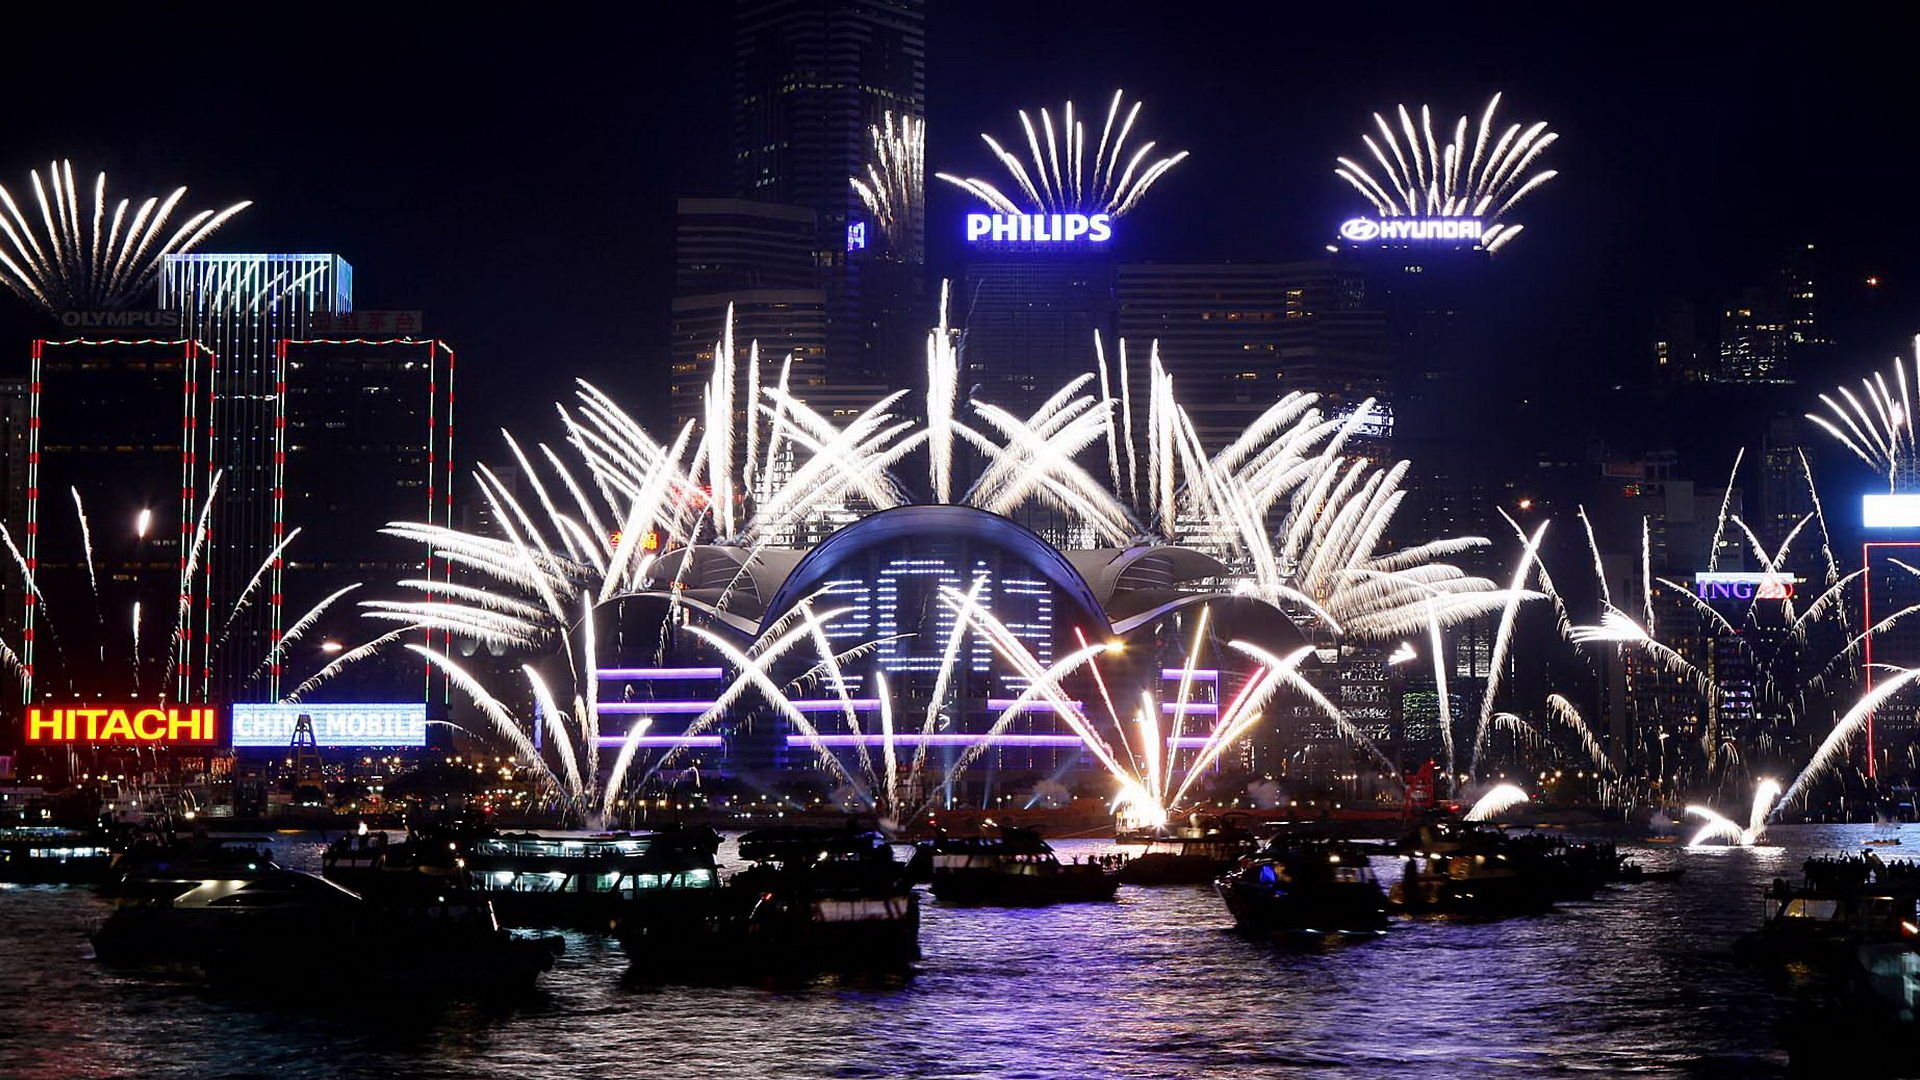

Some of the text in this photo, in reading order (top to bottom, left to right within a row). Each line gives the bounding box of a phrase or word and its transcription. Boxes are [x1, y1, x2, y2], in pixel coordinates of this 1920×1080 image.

[967, 213, 1112, 242] PHILIPS
[1380, 220, 1482, 239] HYUNDAI
[61, 310, 179, 327] OLYMPUS
[1699, 580, 1753, 599] ING
[29, 708, 215, 740] HITACHI
[326, 712, 425, 737] MOBILE
